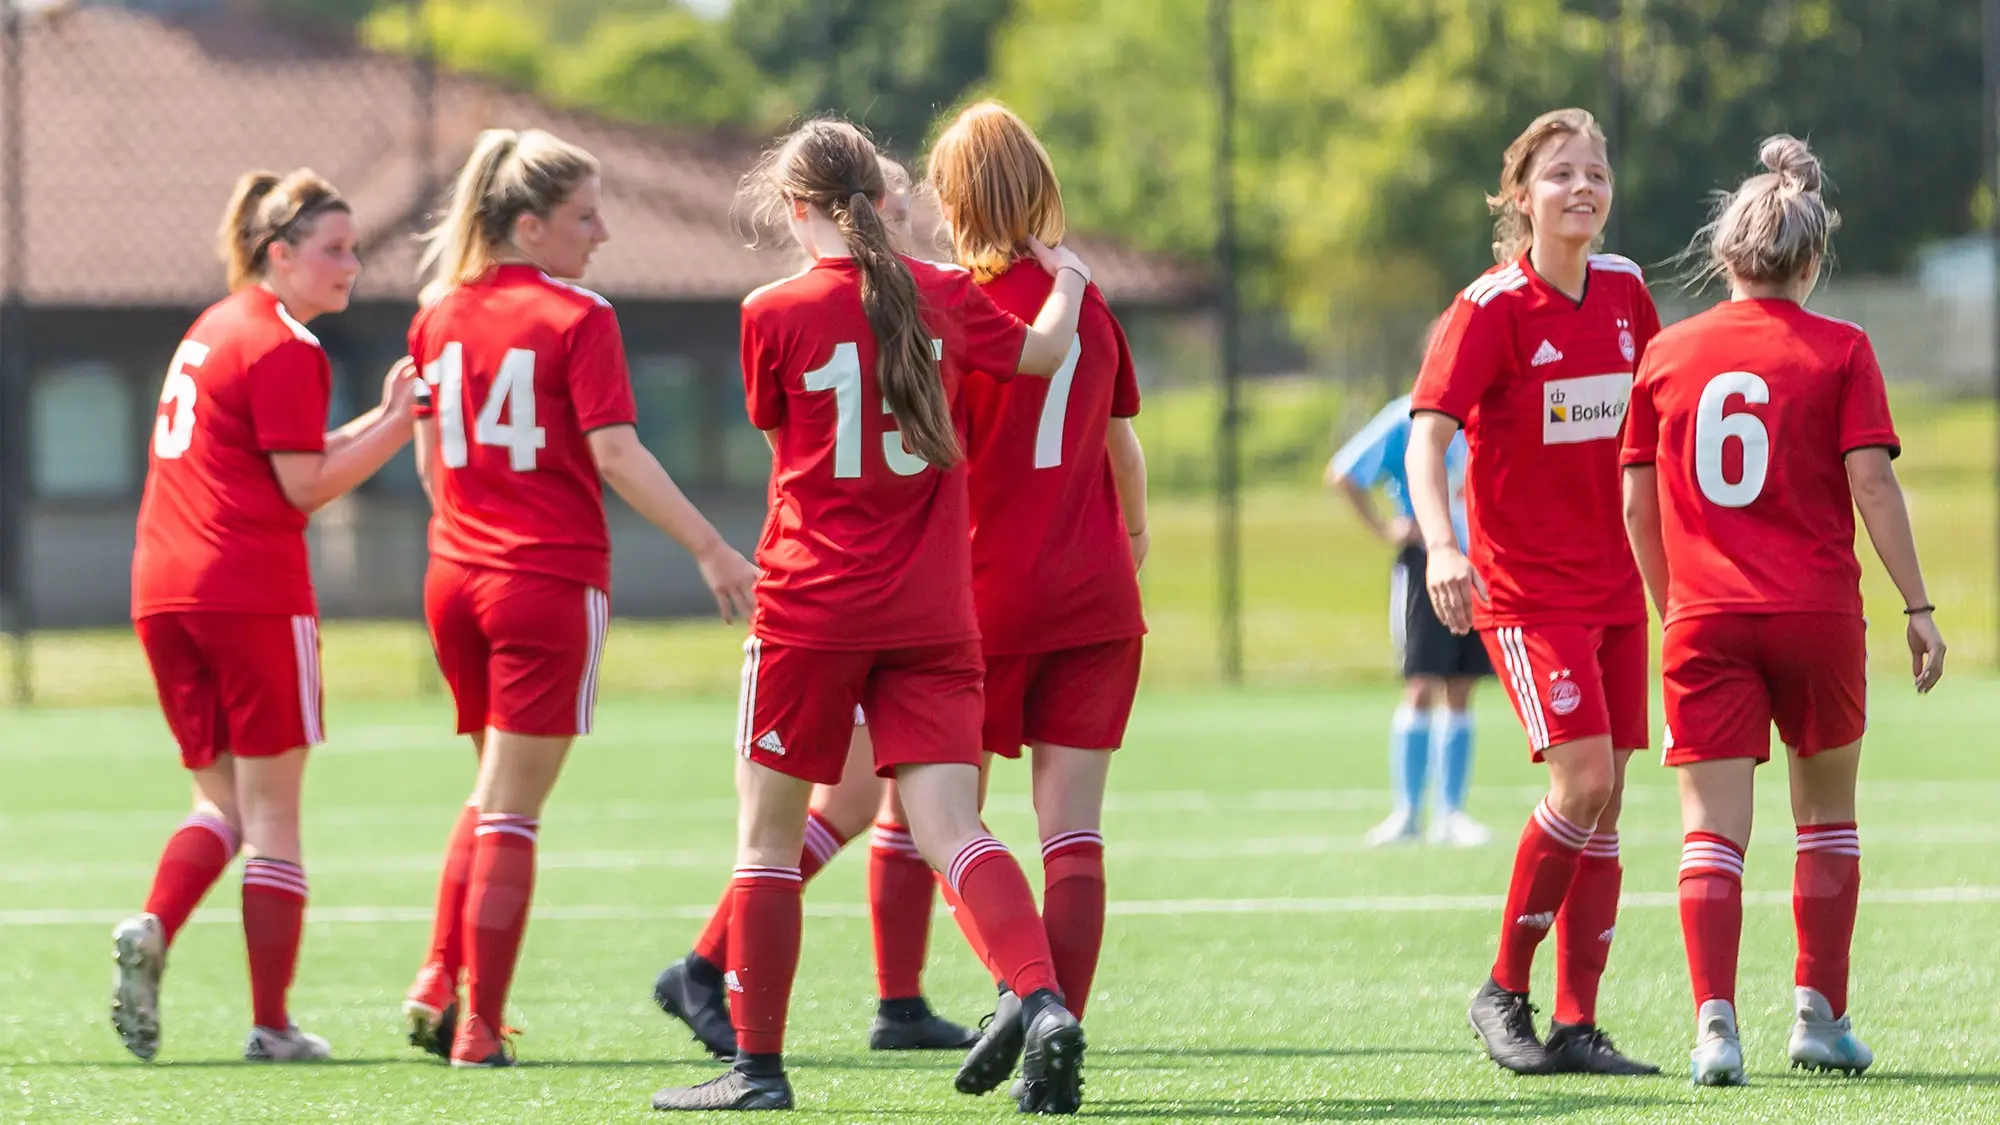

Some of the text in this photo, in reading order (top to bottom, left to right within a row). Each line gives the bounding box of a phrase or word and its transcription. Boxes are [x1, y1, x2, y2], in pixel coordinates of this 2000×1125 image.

[154, 340, 210, 459] 5
[424, 341, 545, 471] 14
[1572, 400, 1625, 422] Bosk
[1696, 371, 1769, 507] 6
